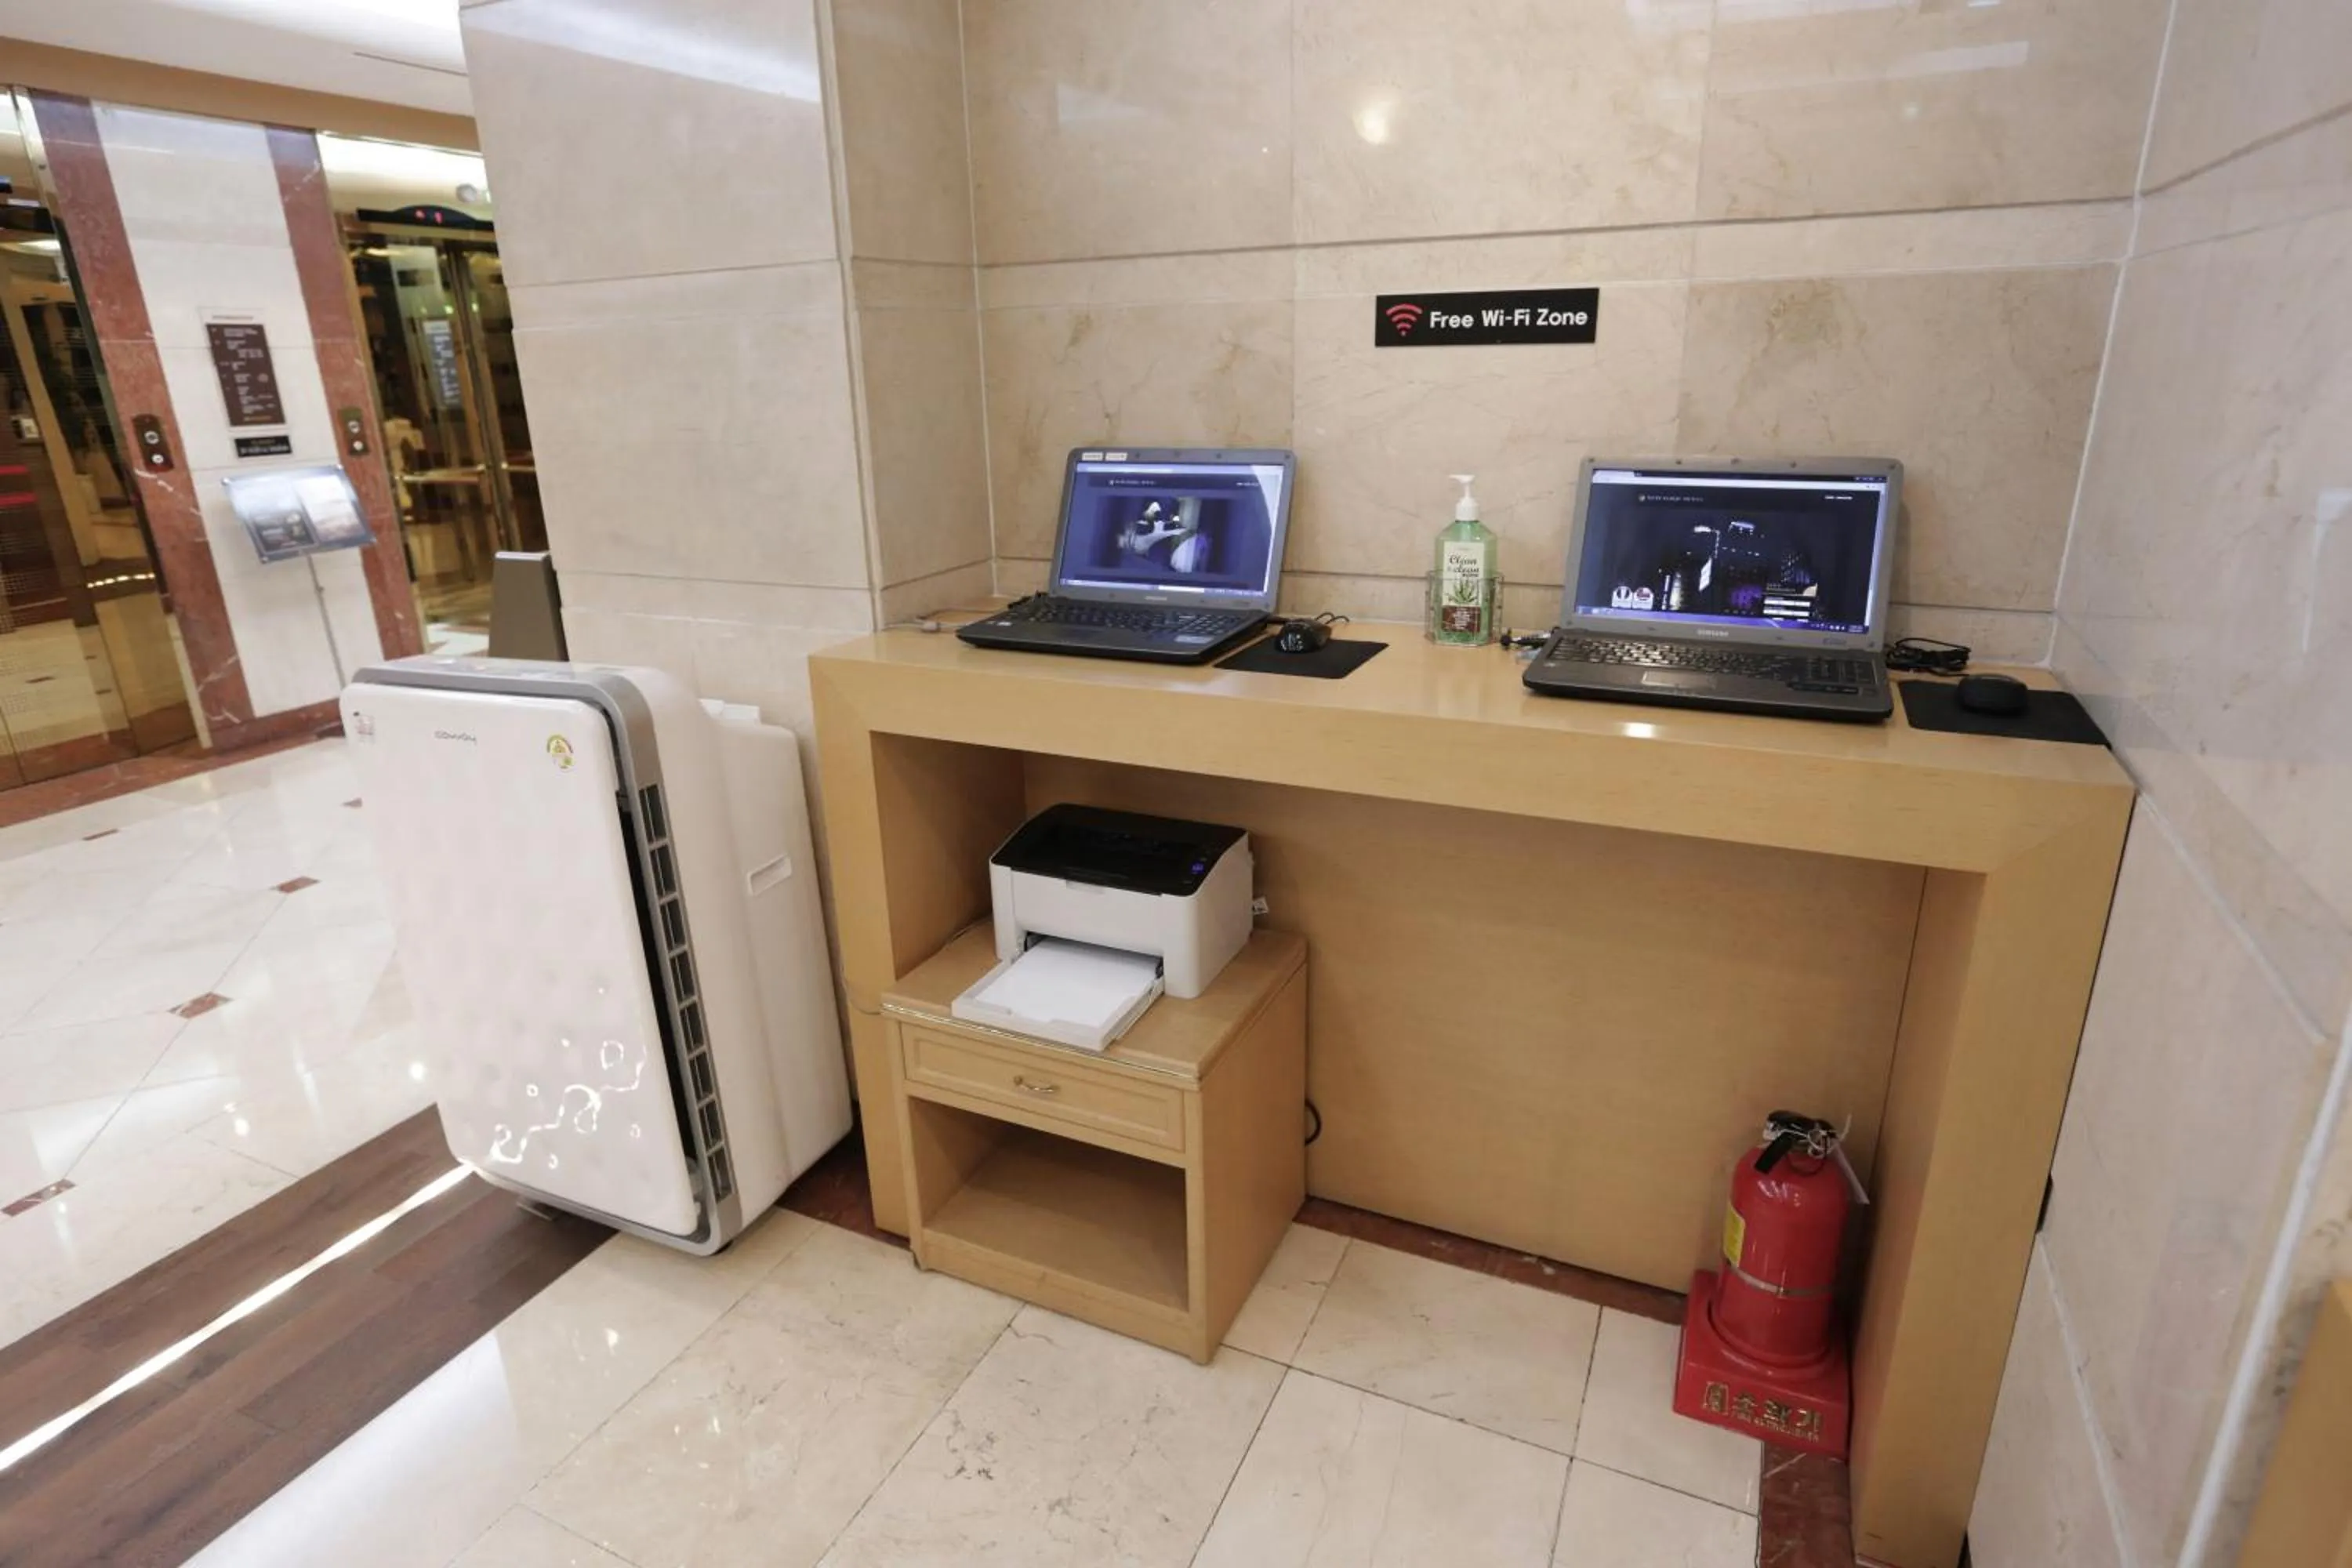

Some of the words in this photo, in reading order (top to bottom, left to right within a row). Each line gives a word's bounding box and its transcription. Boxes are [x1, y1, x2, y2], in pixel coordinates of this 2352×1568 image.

[1429, 310, 1474, 328] Free
[1481, 309, 1530, 327] Wi-Fi
[1536, 308, 1588, 326] Zone
